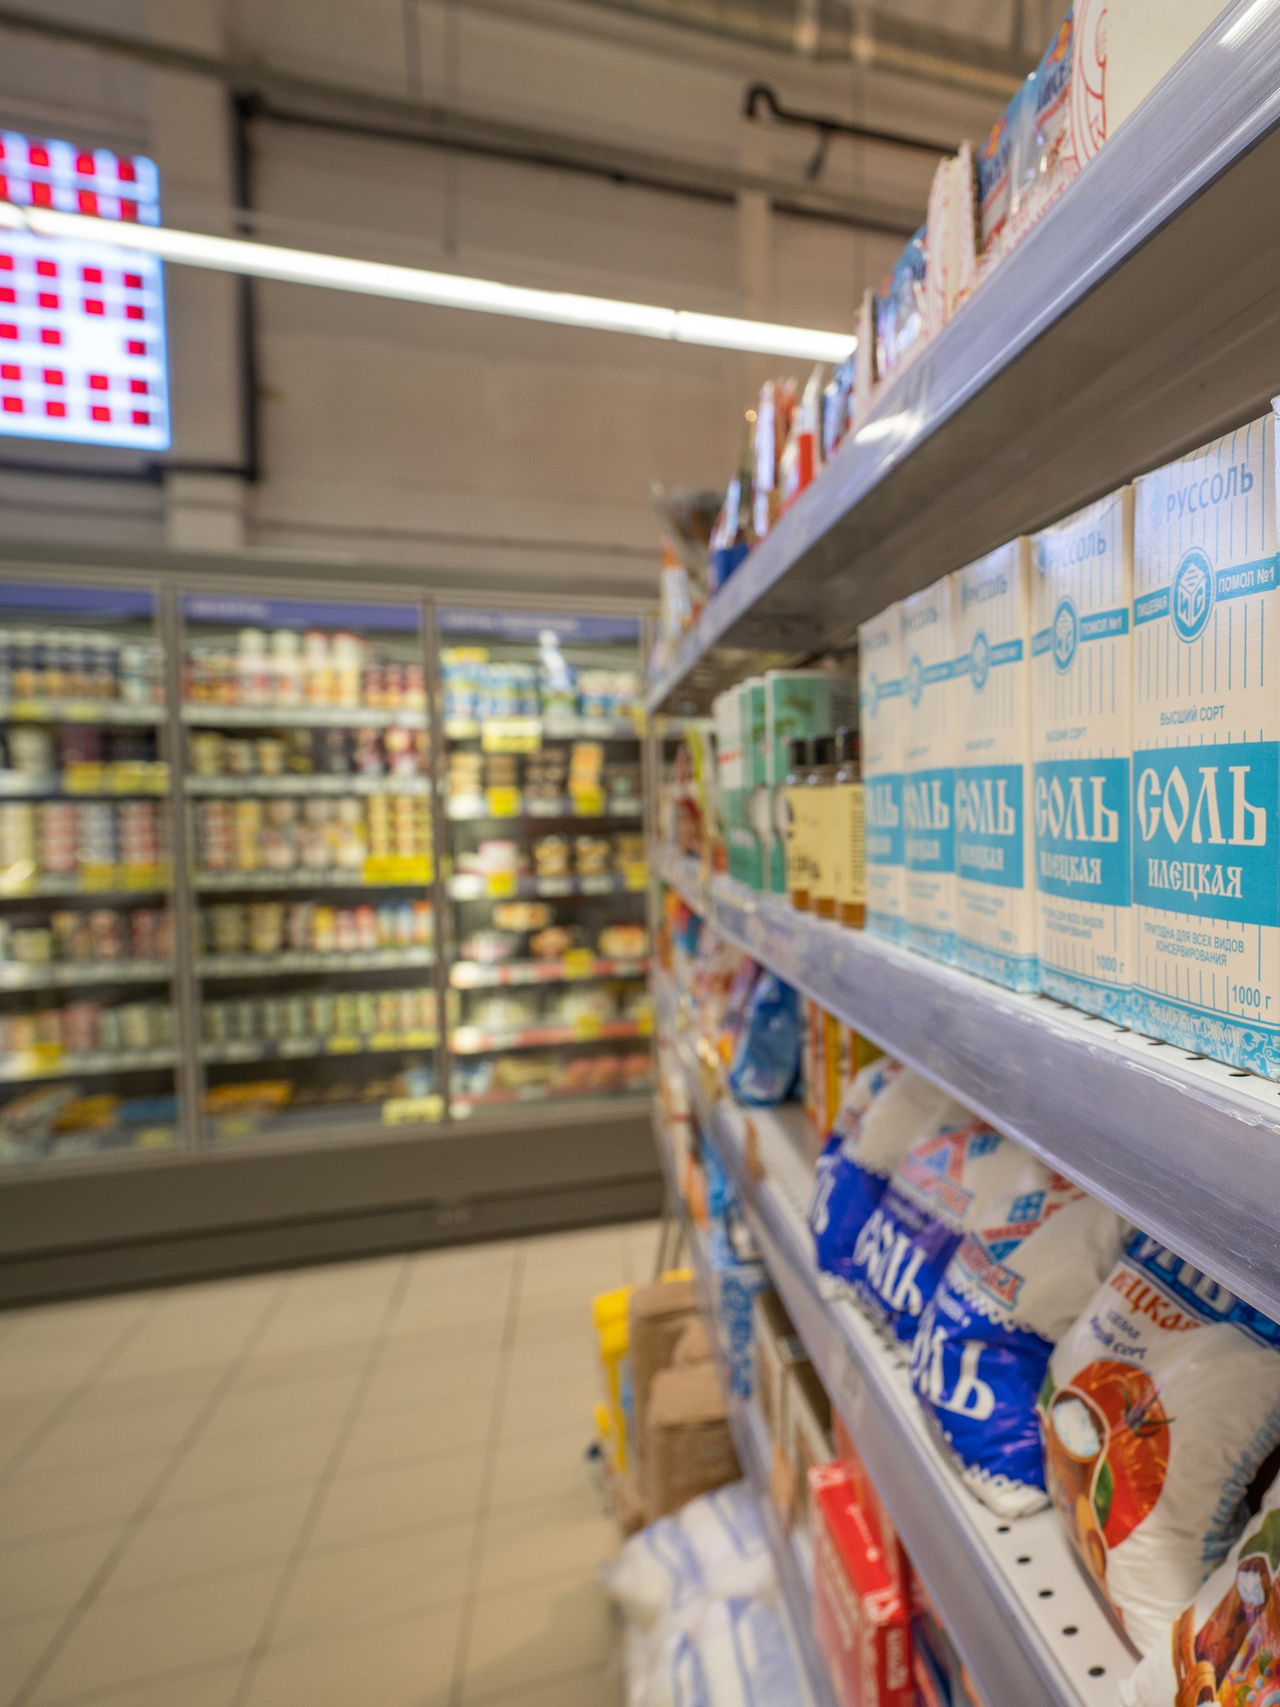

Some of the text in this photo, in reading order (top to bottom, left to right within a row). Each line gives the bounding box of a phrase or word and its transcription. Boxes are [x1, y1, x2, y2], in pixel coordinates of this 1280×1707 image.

[1166, 462, 1254, 523] РУССОЛЬ
[1218, 567, 1274, 593] ПОМОЛ №1
[1160, 705, 1225, 727] ВЫСШИЙ СОРТ
[955, 779, 1015, 837] СОЛЬ
[1036, 775, 1118, 842] СОЛЬ
[1137, 766, 1267, 846] СОЛЬ
[1148, 858, 1243, 901] ИЛЕЦКАЯ
[1192, 932, 1212, 948] ВСЕХ
[1214, 936, 1244, 954] ВИДОВ
[1232, 985, 1272, 1009] 1000 г
